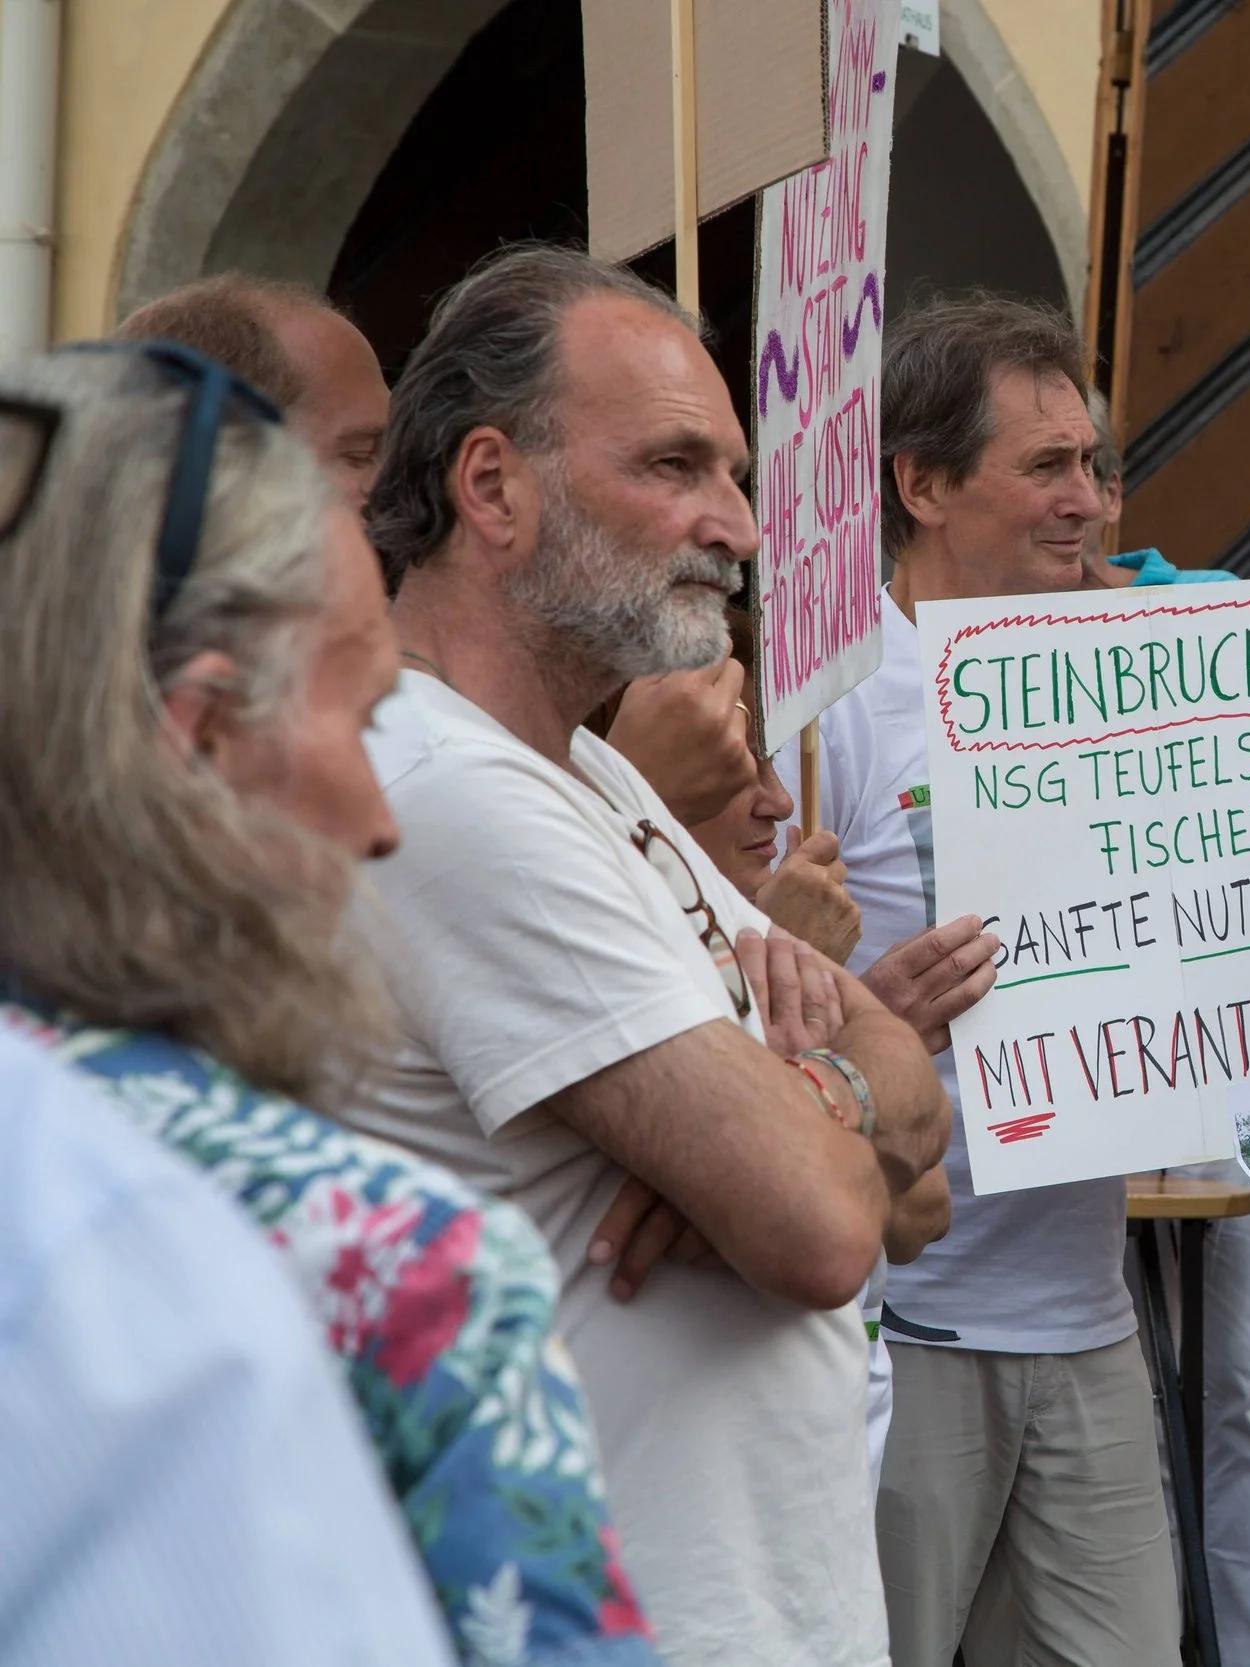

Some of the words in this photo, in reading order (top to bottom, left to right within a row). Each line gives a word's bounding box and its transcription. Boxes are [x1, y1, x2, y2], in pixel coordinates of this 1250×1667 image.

[780, 141, 868, 299] NUTZUNG
[799, 274, 849, 429] STATT
[760, 431, 805, 580] HOHE
[814, 375, 876, 533] KOSTEN
[762, 572, 793, 719] FÜR
[793, 492, 881, 692] ÜBERWACHUNG
[974, 762, 1067, 809] NSG
[982, 891, 1157, 969] SANFTE
[974, 1032, 1056, 1110] MIT
